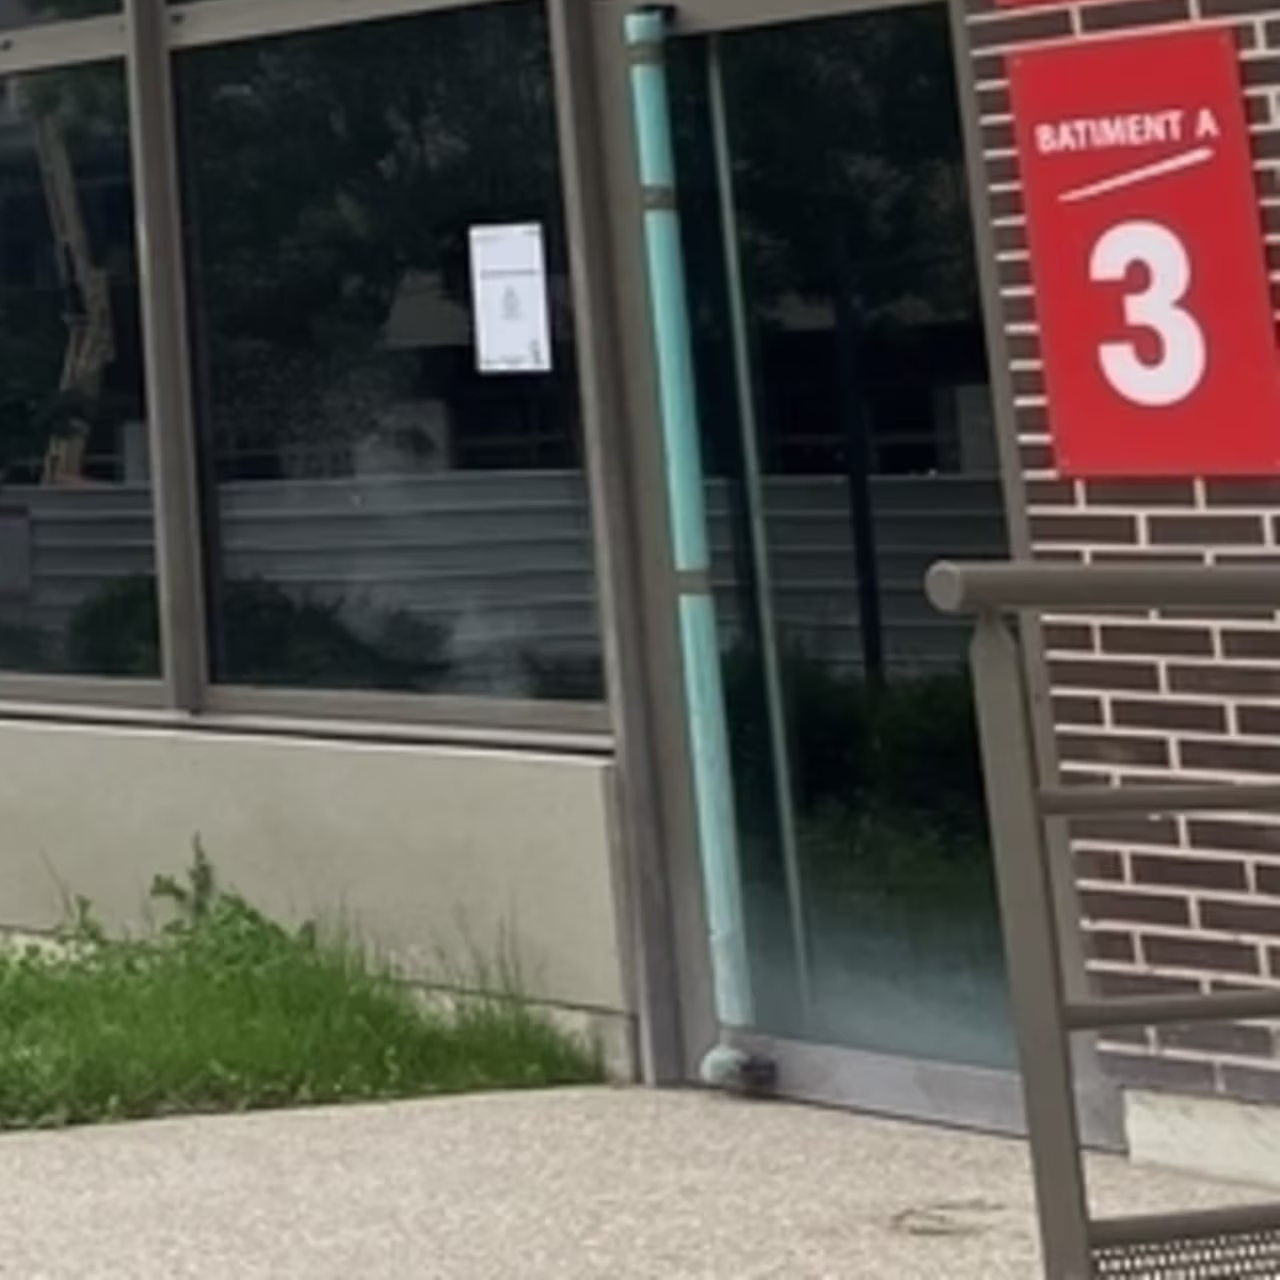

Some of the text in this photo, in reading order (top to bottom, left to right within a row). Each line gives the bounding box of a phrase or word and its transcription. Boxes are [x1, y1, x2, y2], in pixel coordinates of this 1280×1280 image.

[1034, 107, 1220, 155] BATIMENT A
[1089, 219, 1207, 406] 3
